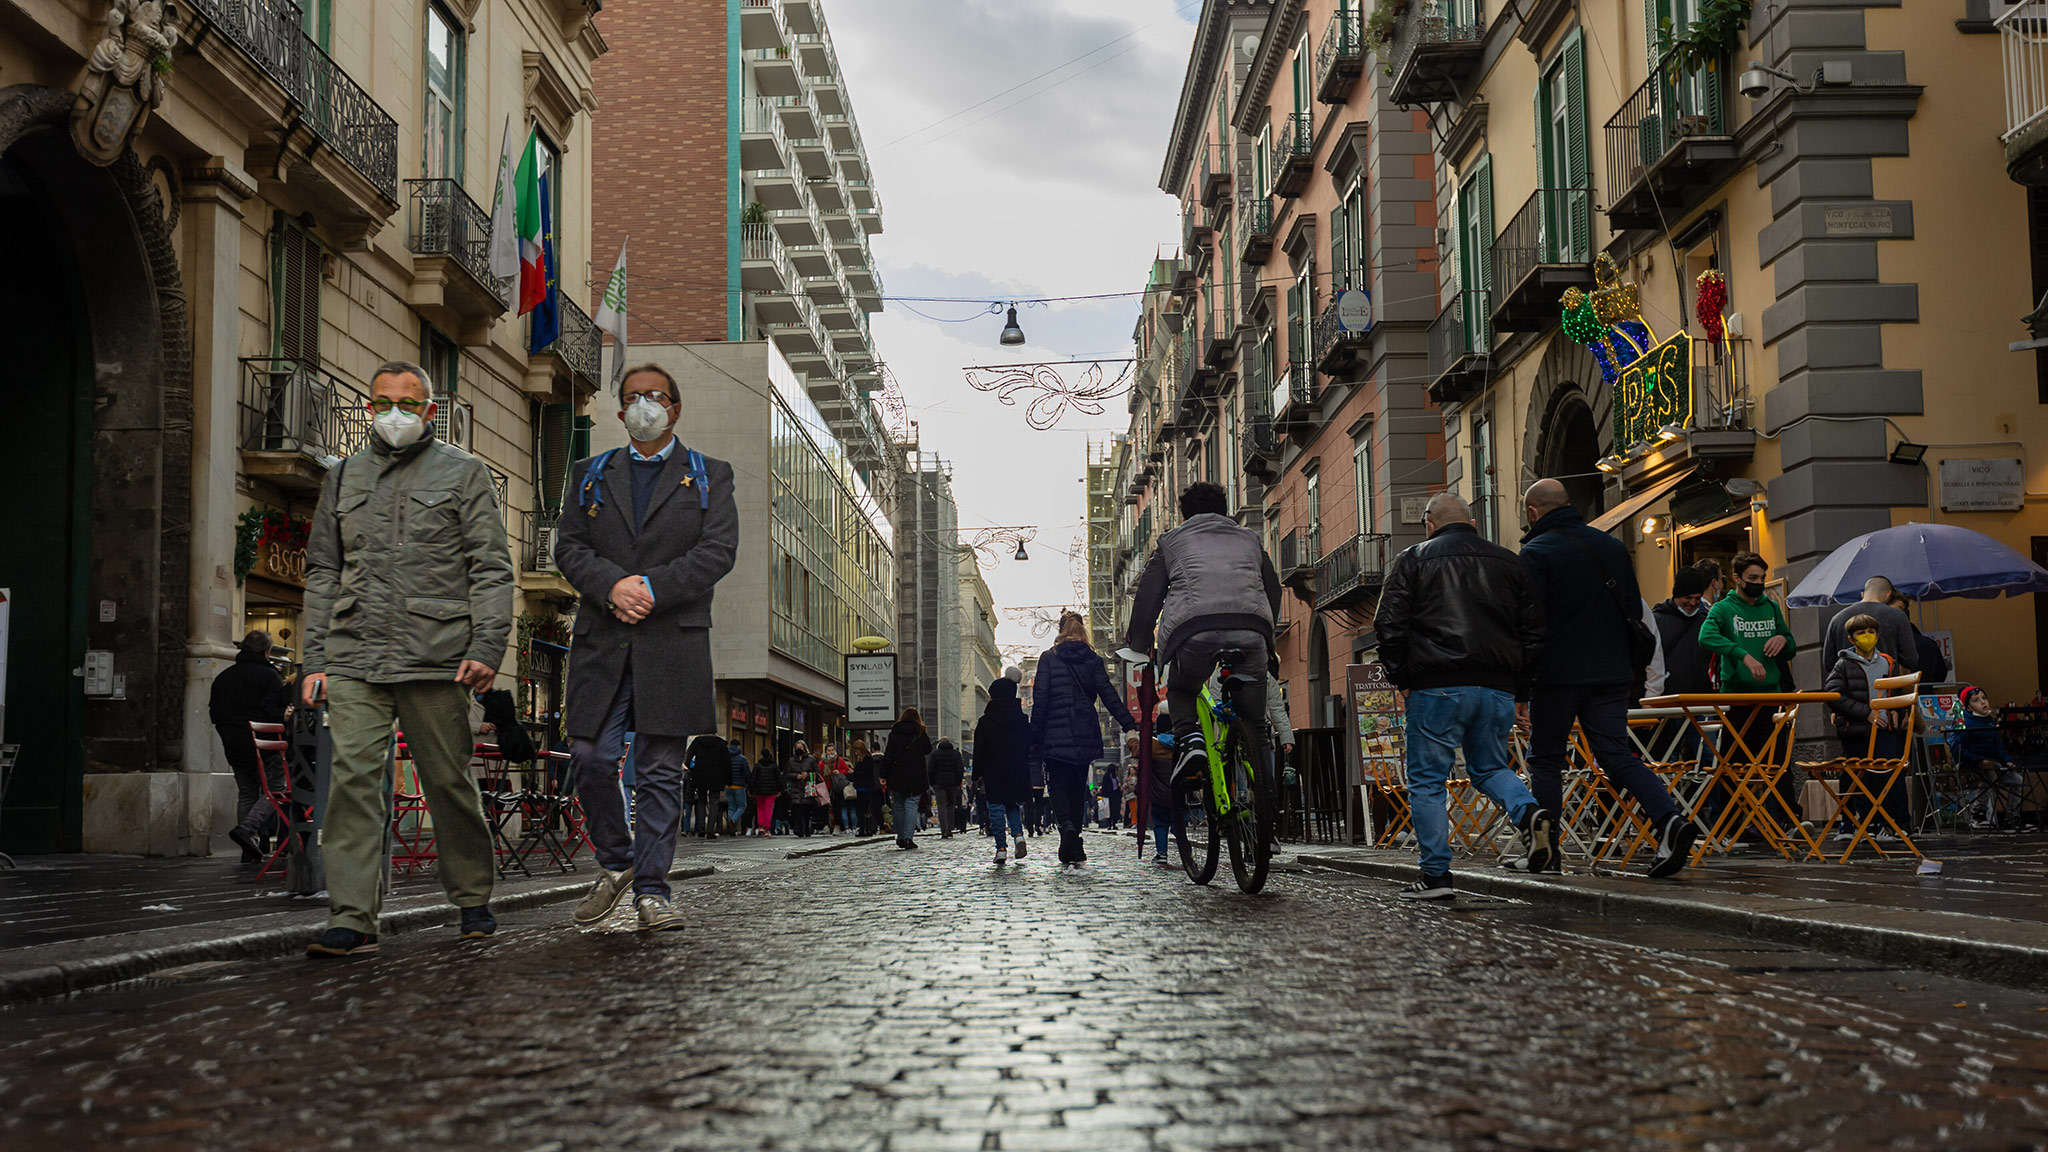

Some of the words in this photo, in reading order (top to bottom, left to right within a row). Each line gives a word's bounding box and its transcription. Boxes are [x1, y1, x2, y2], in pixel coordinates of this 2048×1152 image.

[1826, 210, 1844, 218] VICO
[1827, 220, 1891, 229] MONTECALVARIO
[1738, 619, 1776, 632] BOXEUR
[850, 663, 883, 671] SYNLAB
